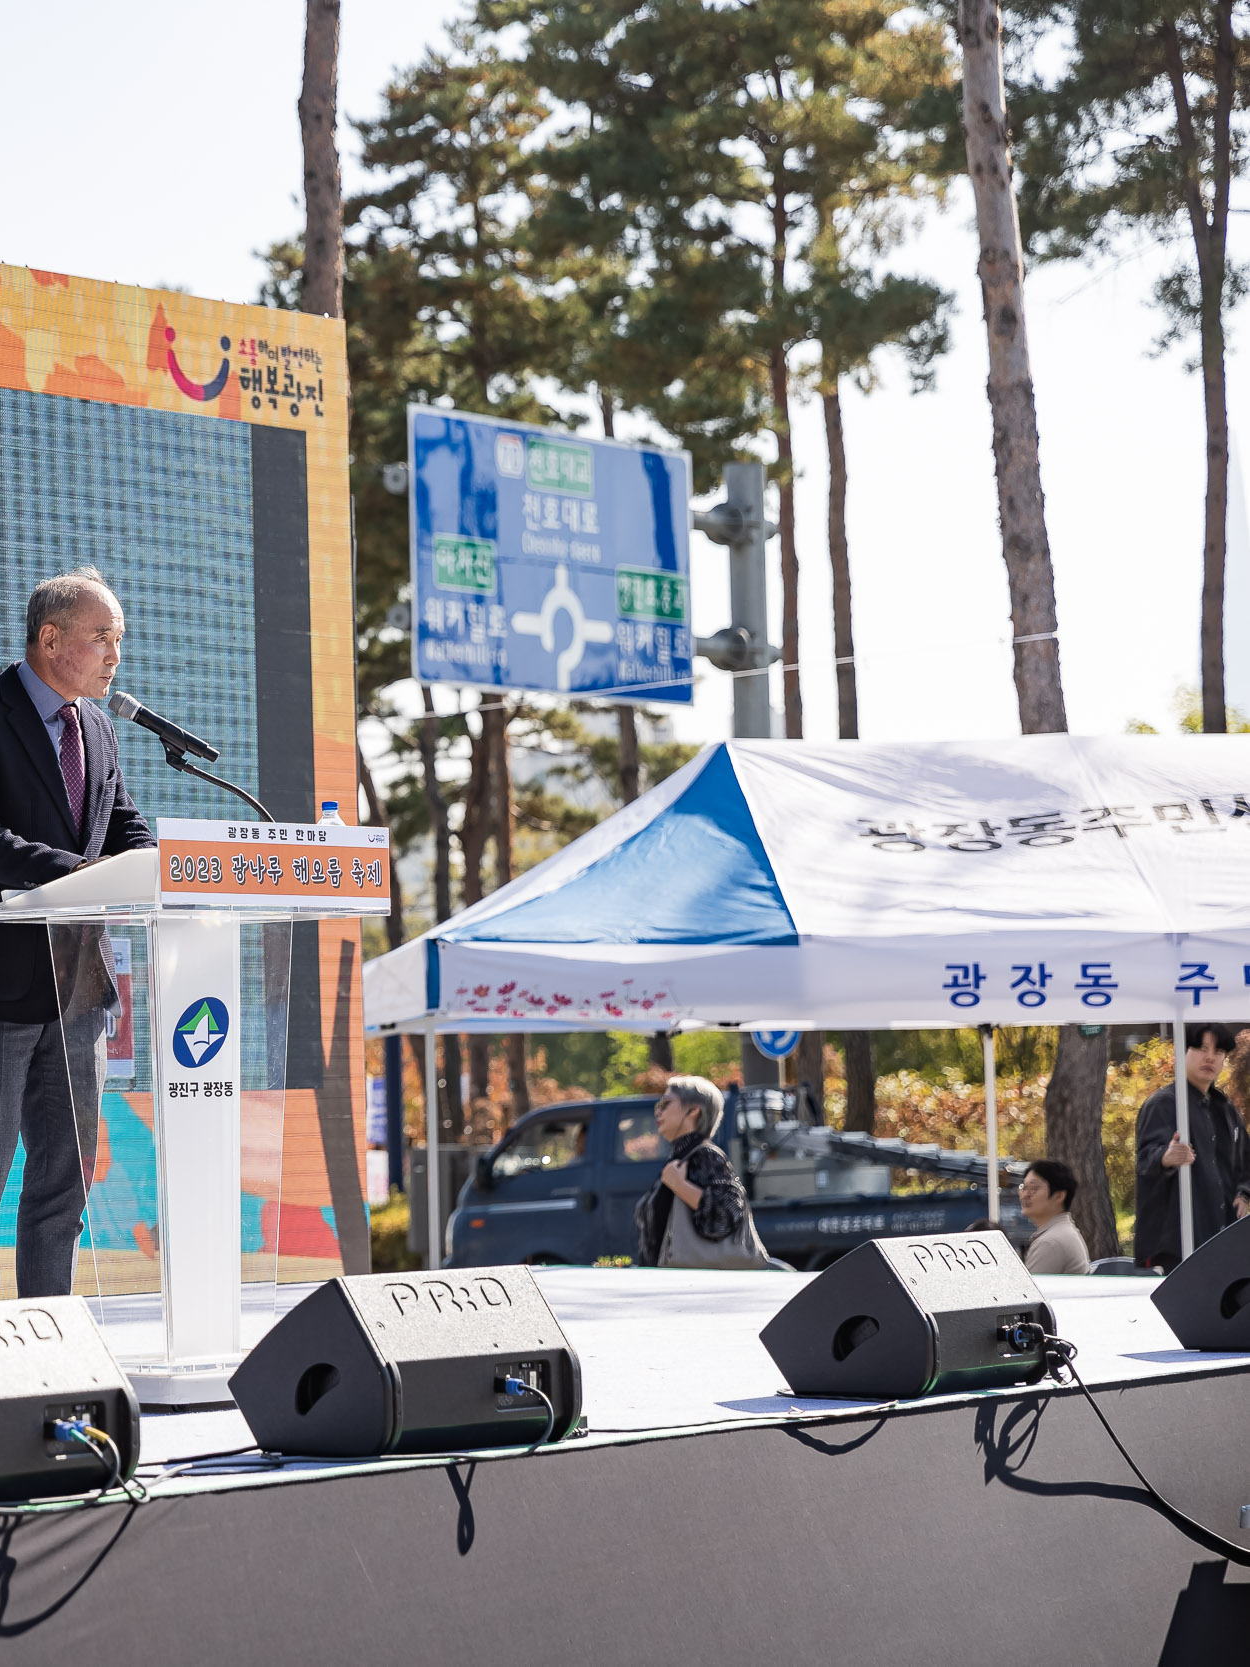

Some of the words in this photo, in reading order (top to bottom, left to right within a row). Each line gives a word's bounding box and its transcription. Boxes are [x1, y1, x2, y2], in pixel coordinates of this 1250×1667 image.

[238, 338, 279, 366] 소통하며
[280, 345, 323, 374] 발전하는
[238, 366, 324, 417] 행복광진
[522, 492, 600, 534] 천호대로
[227, 826, 260, 840] 광장동
[268, 828, 288, 841] 주민
[295, 829, 327, 842] 한마당
[169, 854, 223, 883] 2023
[231, 853, 284, 886] 광나루
[292, 855, 343, 889] 해오름
[350, 857, 383, 889] 축제
[168, 1082, 199, 1098] 광진구
[203, 1081, 234, 1098] 광장동
